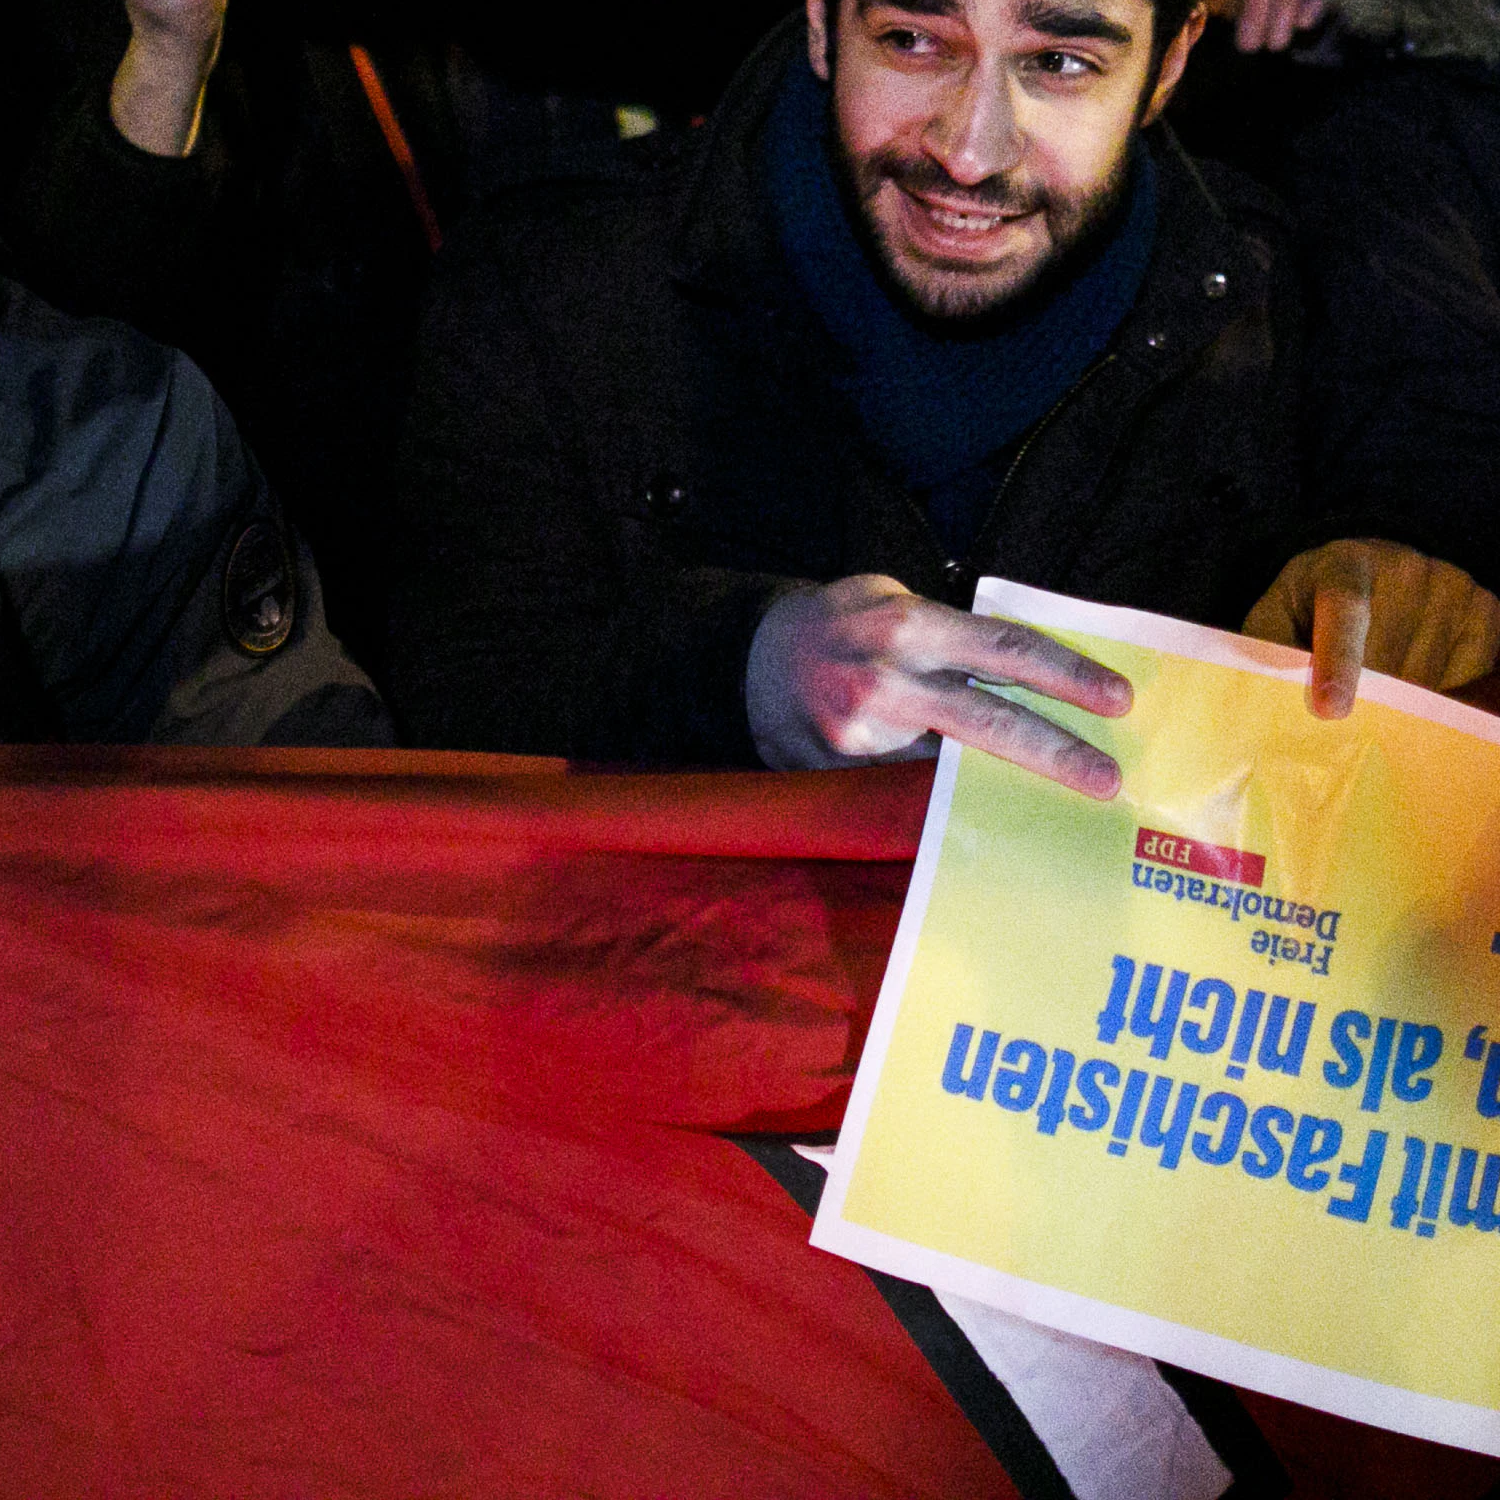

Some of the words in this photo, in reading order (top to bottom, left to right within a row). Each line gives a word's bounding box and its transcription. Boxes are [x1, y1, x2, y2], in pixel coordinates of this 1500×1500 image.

[1143, 836, 1192, 865] FDP
[1132, 862, 1342, 942] Demokraten
[1250, 929, 1334, 976] Freie
[1097, 953, 1317, 1081] nicht
[1324, 1007, 1445, 1104] als
[941, 1021, 1391, 1228] Faschisten
